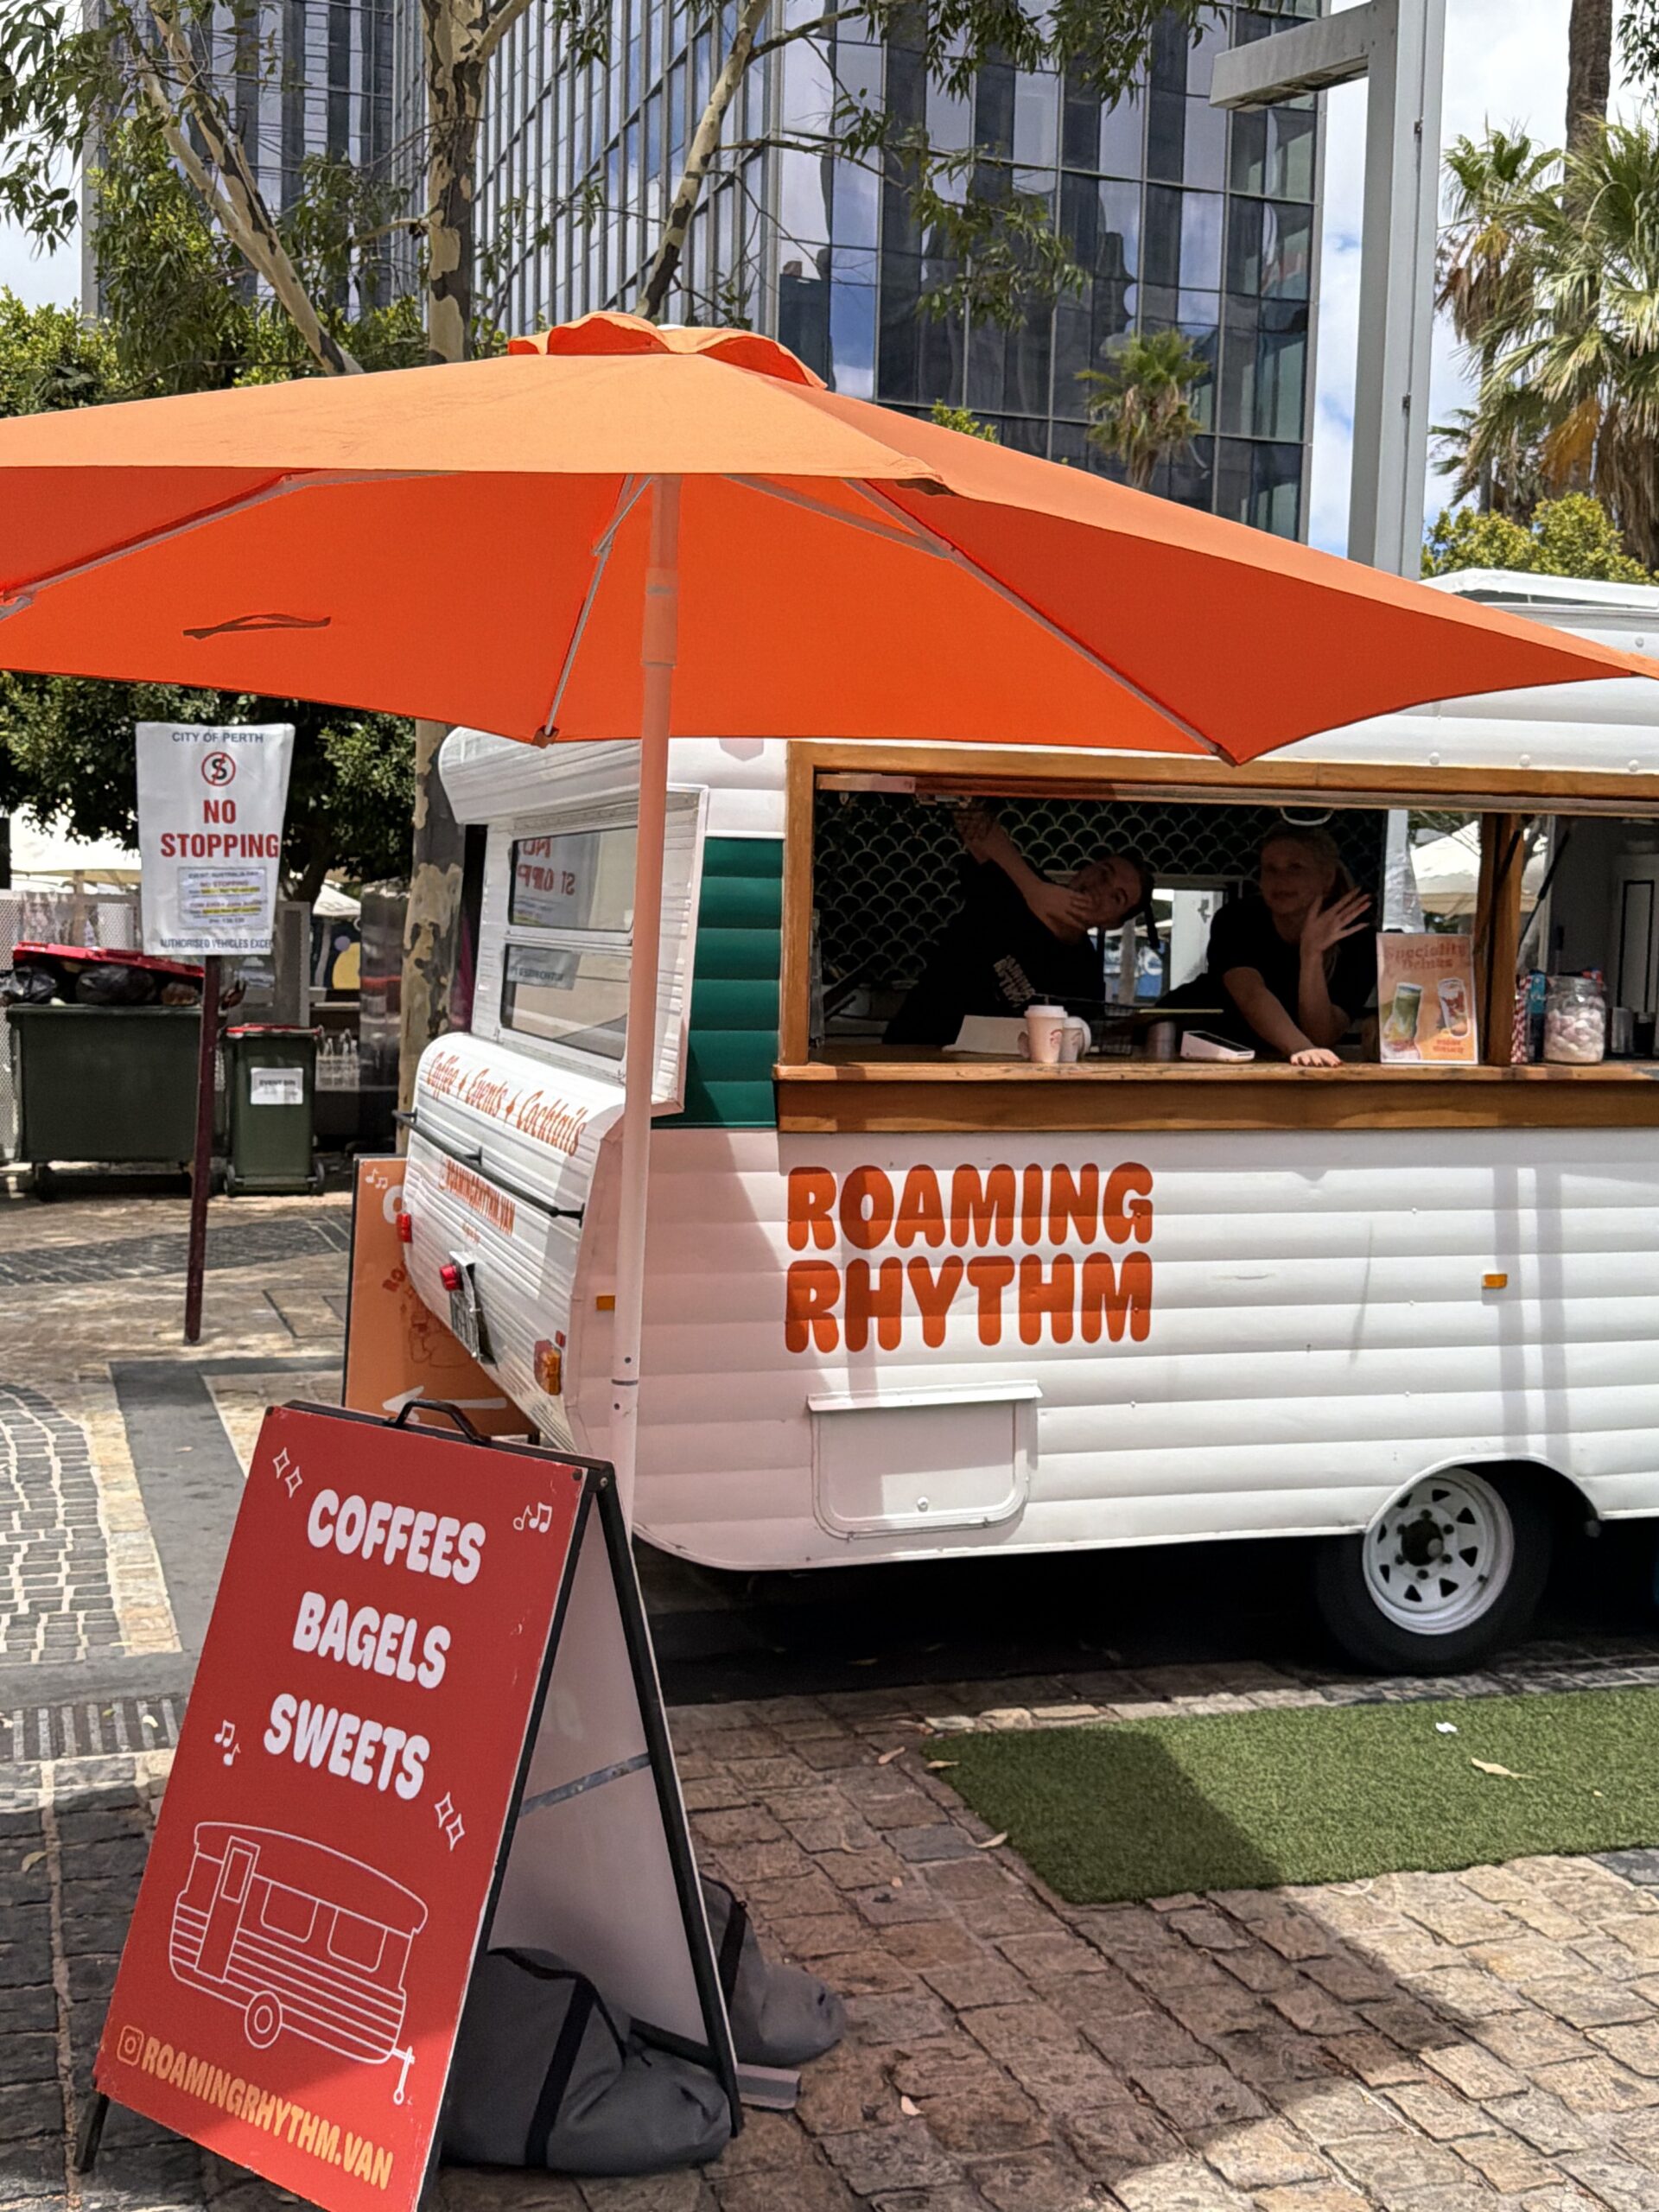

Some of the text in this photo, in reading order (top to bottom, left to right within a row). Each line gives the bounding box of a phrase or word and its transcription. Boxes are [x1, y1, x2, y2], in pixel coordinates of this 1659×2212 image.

[172, 731, 264, 743] CITY OF PERTH
[161, 833, 279, 858] STOPPING
[203, 799, 236, 824] NO
[212, 938, 249, 949] VEHICLES
[251, 938, 274, 949] EXCE
[465, 1068, 508, 1118] Events
[516, 1090, 588, 1157] Cocktails
[787, 1161, 1154, 1251] ROAMING
[785, 1250, 1152, 1353] RHYTHM
[307, 1488, 486, 1585] COFFEES
[292, 1591, 451, 1689] BAGELS
[263, 1693, 431, 1801] SWEETS
[141, 2037, 394, 2191] ROAMINGRHYTHM.VAN
